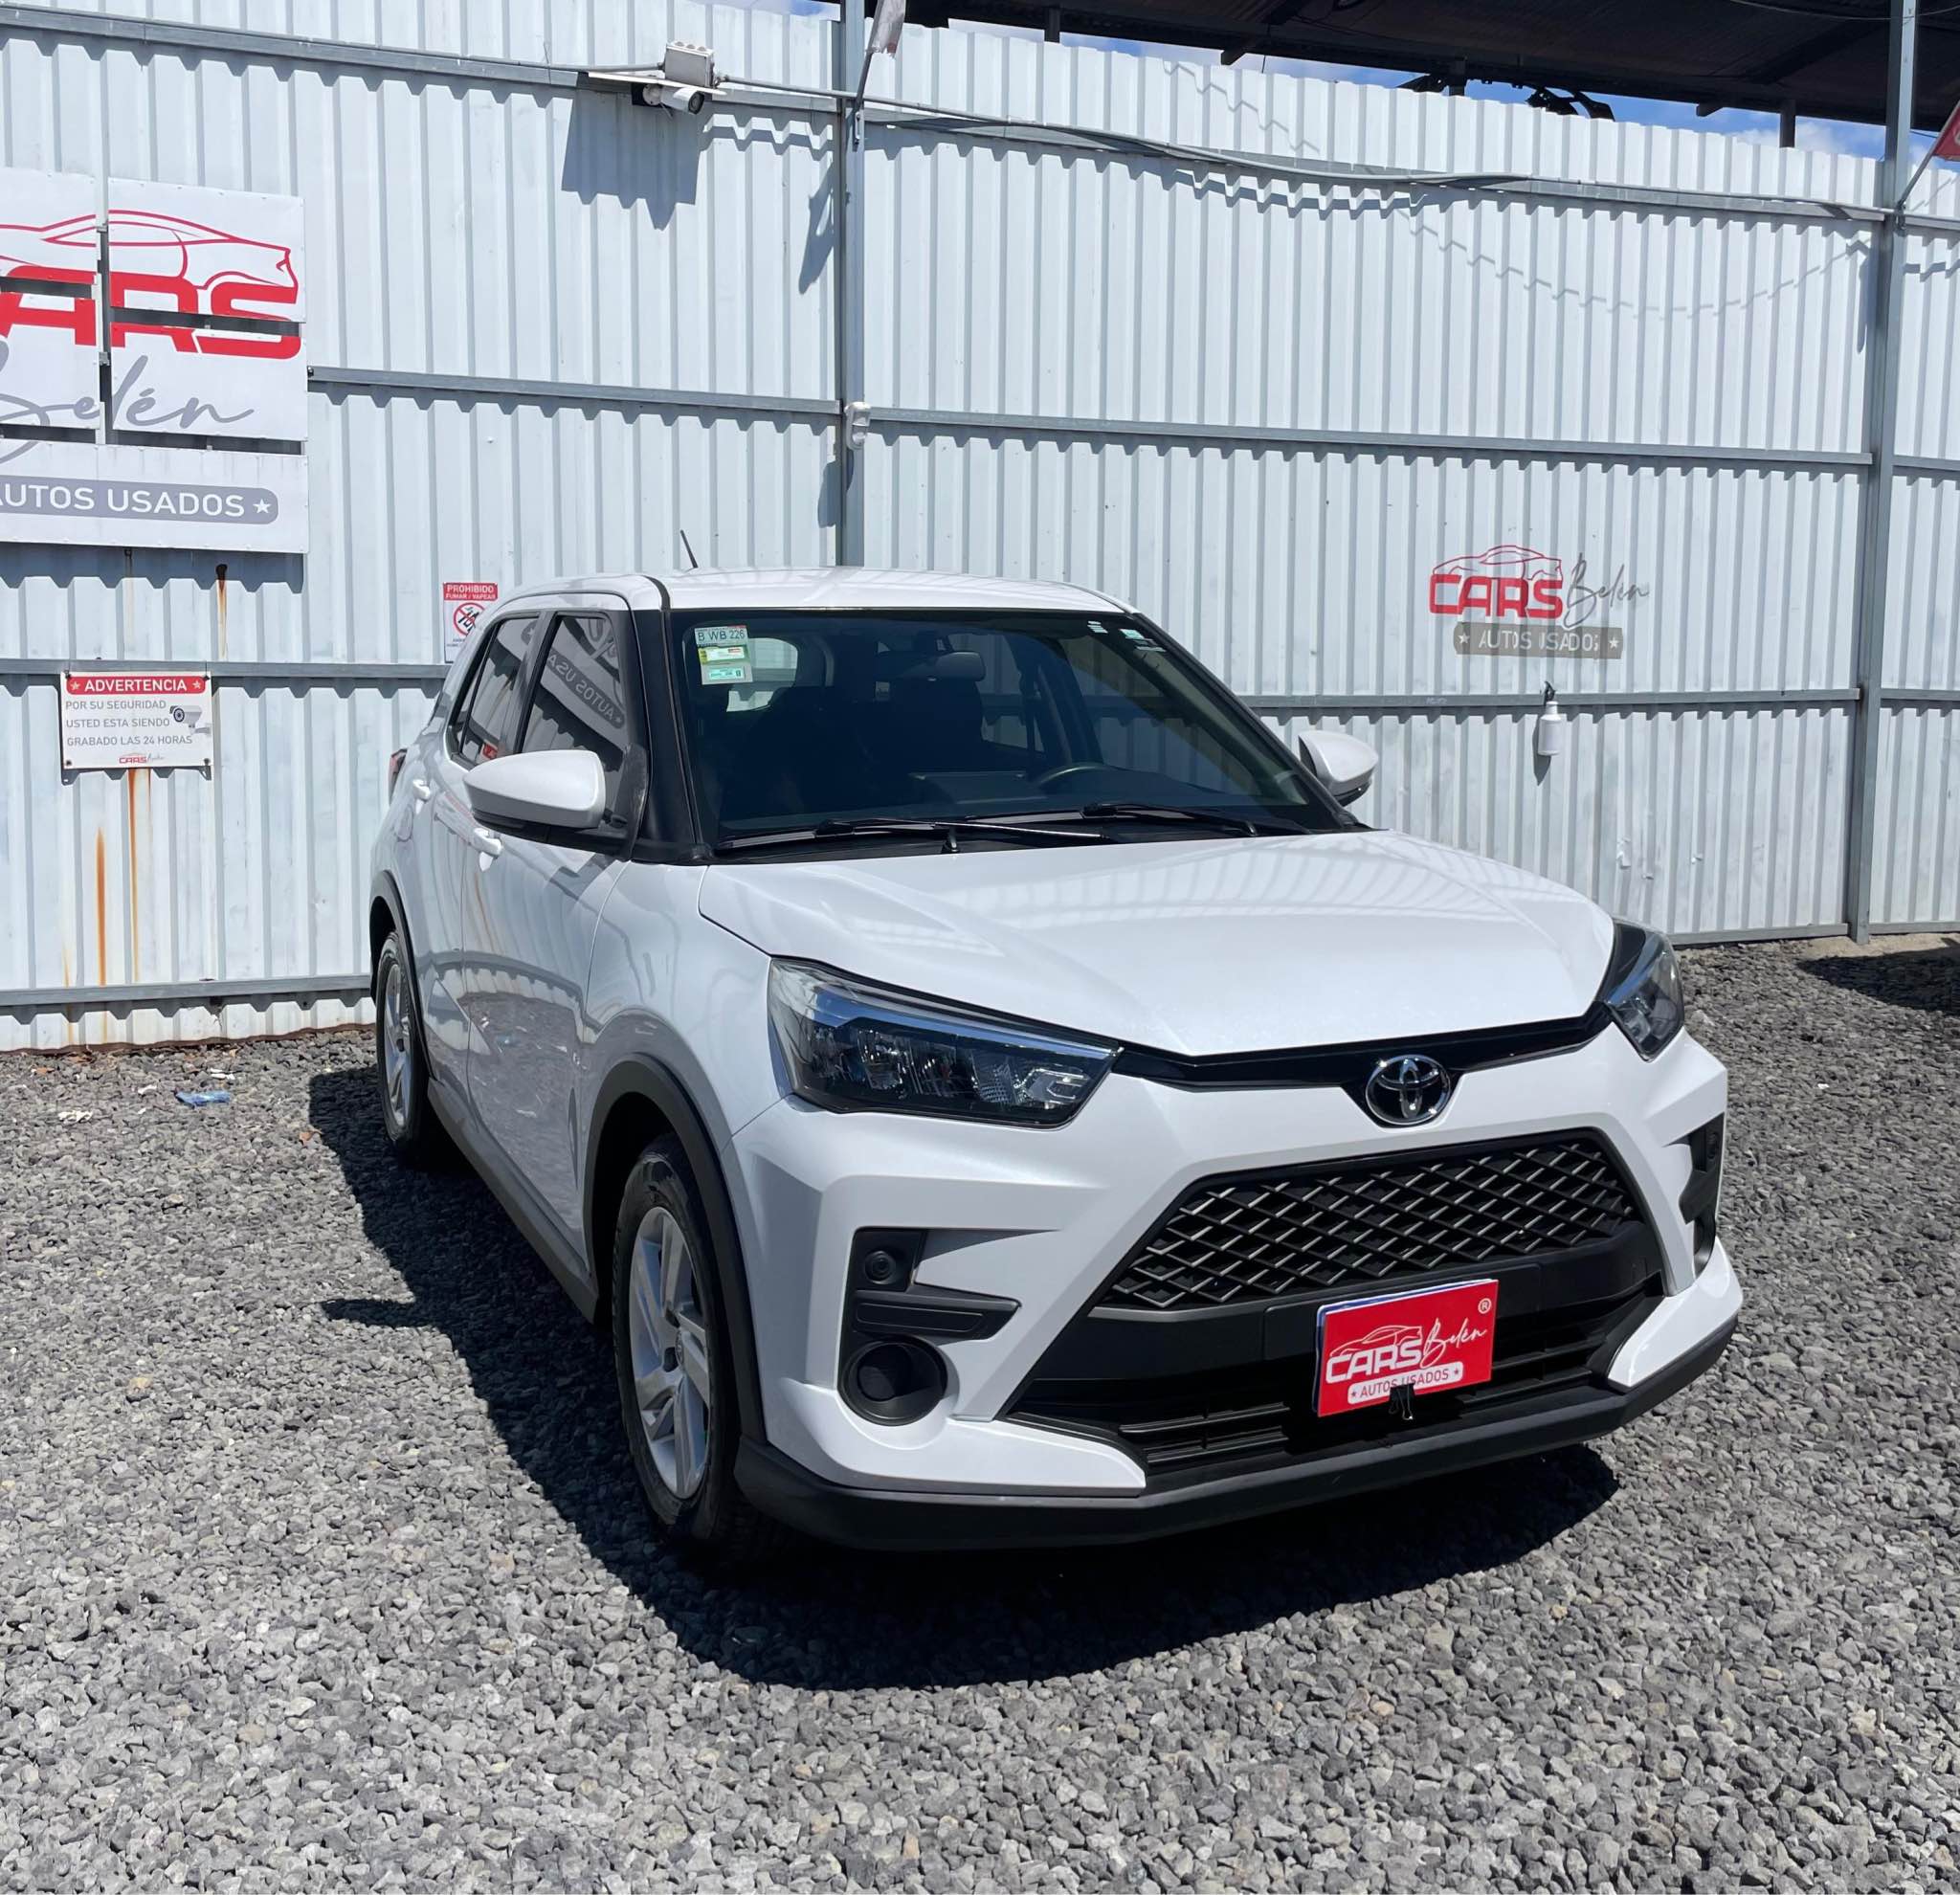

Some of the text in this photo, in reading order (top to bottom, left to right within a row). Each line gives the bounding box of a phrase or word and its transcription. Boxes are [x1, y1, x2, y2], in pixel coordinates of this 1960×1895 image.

[0, 265, 301, 360] ARS
[0, 484, 245, 517] UTOS USADOS
[446, 585, 494, 593] PROHIBIDO
[1429, 573, 1564, 619] CARS
[84, 679, 188, 692] ADVERTENCIA
[65, 700, 167, 710] POR SU SEGURIDAD
[66, 718, 170, 728] USTED ESTA SIENDO
[67, 735, 192, 747] GRABADO LAS 24 HORAS
[1325, 1338, 1423, 1384] CARS
[1359, 1378, 1398, 1398] AUTOS
